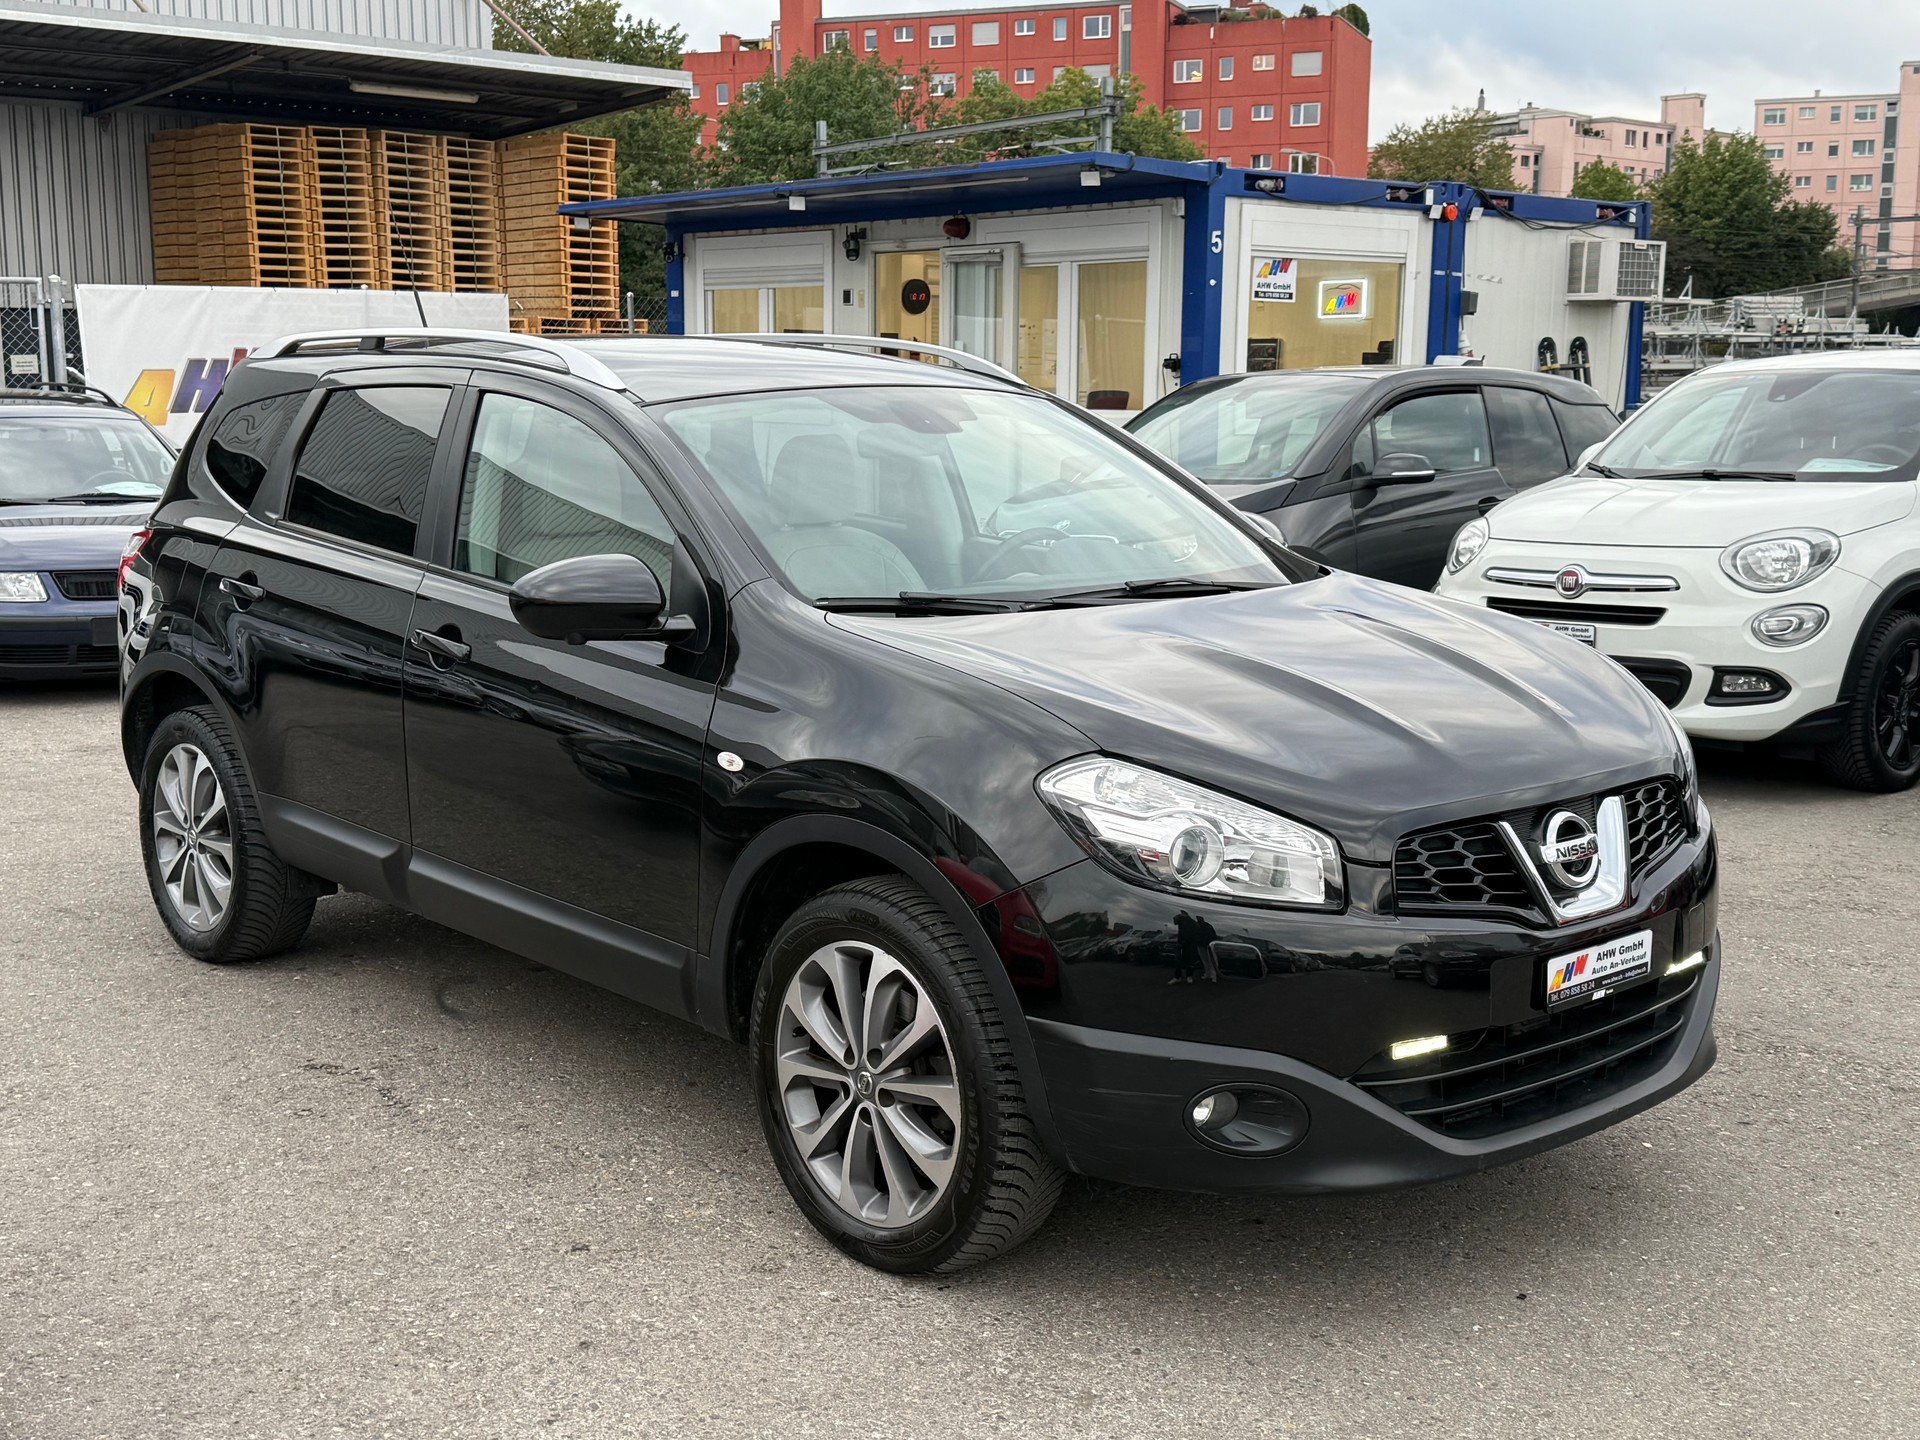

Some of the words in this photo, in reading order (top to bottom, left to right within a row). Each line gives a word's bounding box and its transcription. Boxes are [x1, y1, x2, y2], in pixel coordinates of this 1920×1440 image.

[1211, 230, 1222, 254] 5
[1256, 258, 1293, 278] AHW
[1272, 282, 1291, 290] GmbH
[1325, 292, 1358, 313] AHW
[123, 347, 260, 425] AH
[1562, 576, 1577, 588] FIAT
[1596, 948, 1617, 962] AHW
[1618, 939, 1644, 955] GmbH
[1548, 953, 1589, 992] AHW
[1591, 965, 1608, 976] Auto
[1609, 951, 1647, 970] An-Verkauf
[1550, 992, 1560, 1002] Tel.
[1559, 989, 1570, 999] 079
[1588, 981, 1595, 990] 24
